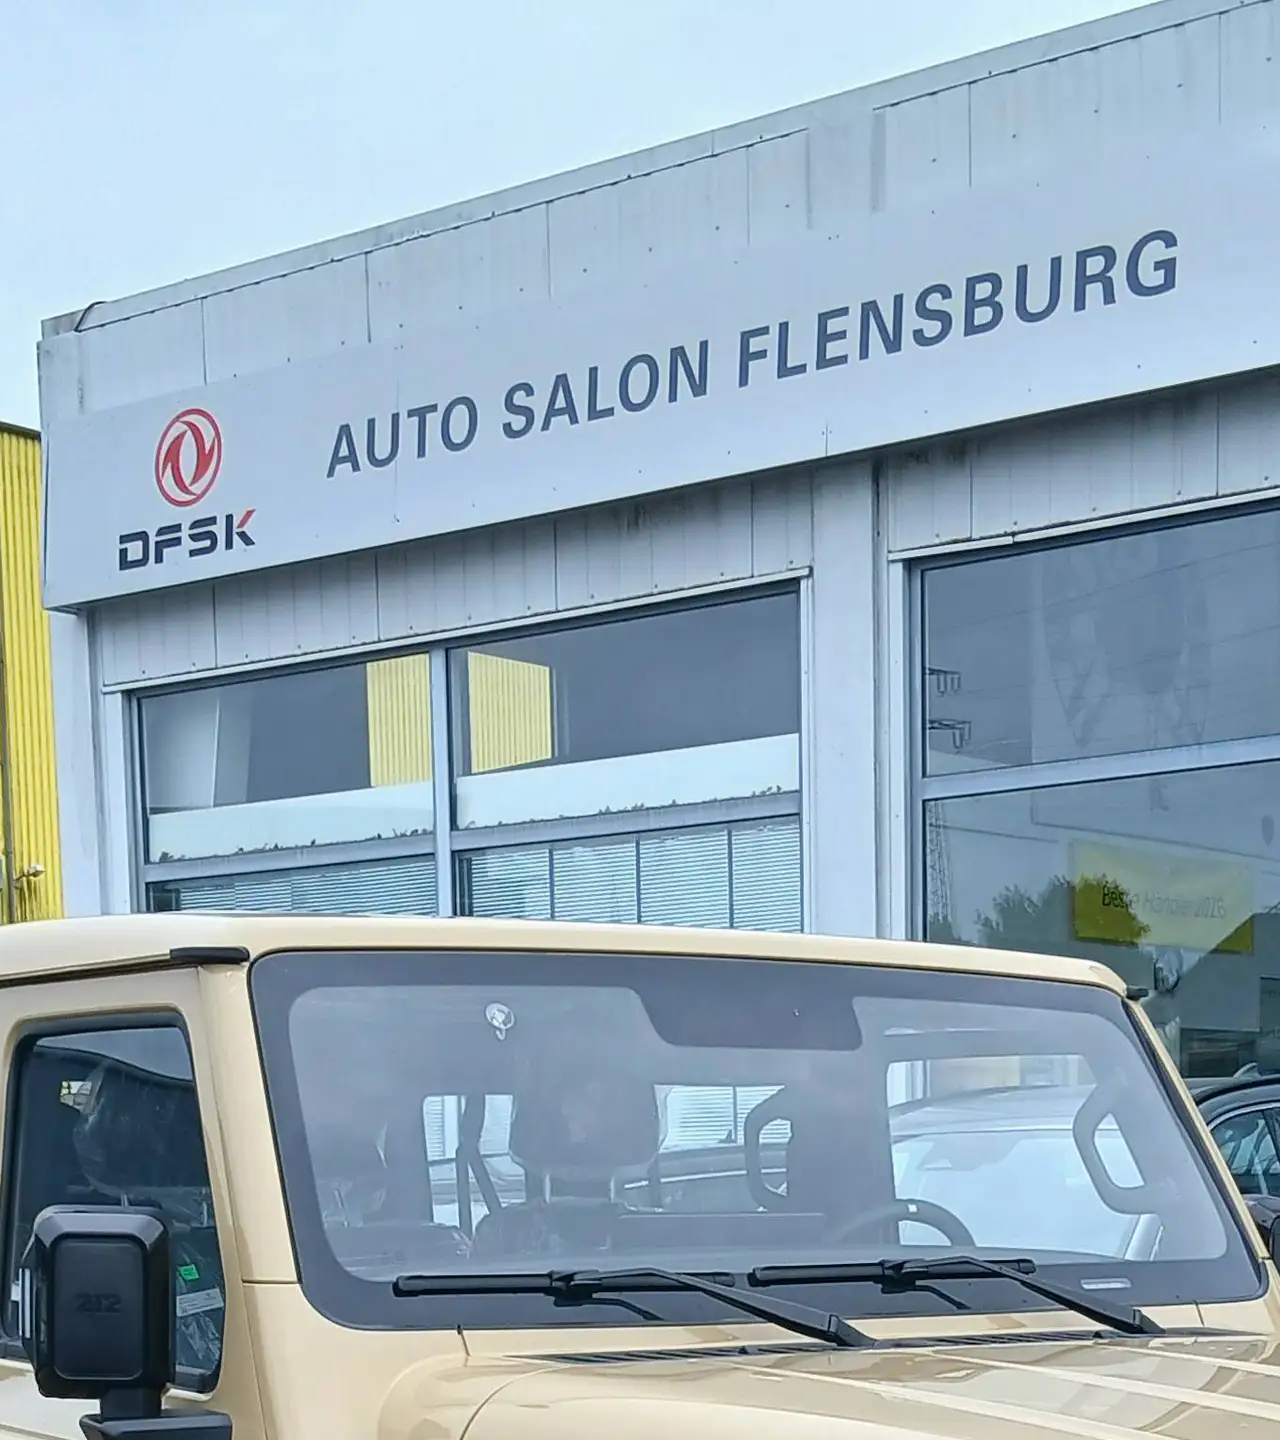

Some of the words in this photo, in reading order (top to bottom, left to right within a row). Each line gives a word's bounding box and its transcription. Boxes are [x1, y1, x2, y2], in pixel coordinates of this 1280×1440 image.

[327, 395, 479, 478] AUTO
[501, 338, 710, 439] SALON
[737, 229, 1180, 389] FLENSBURG
[118, 508, 257, 571] DFSK
